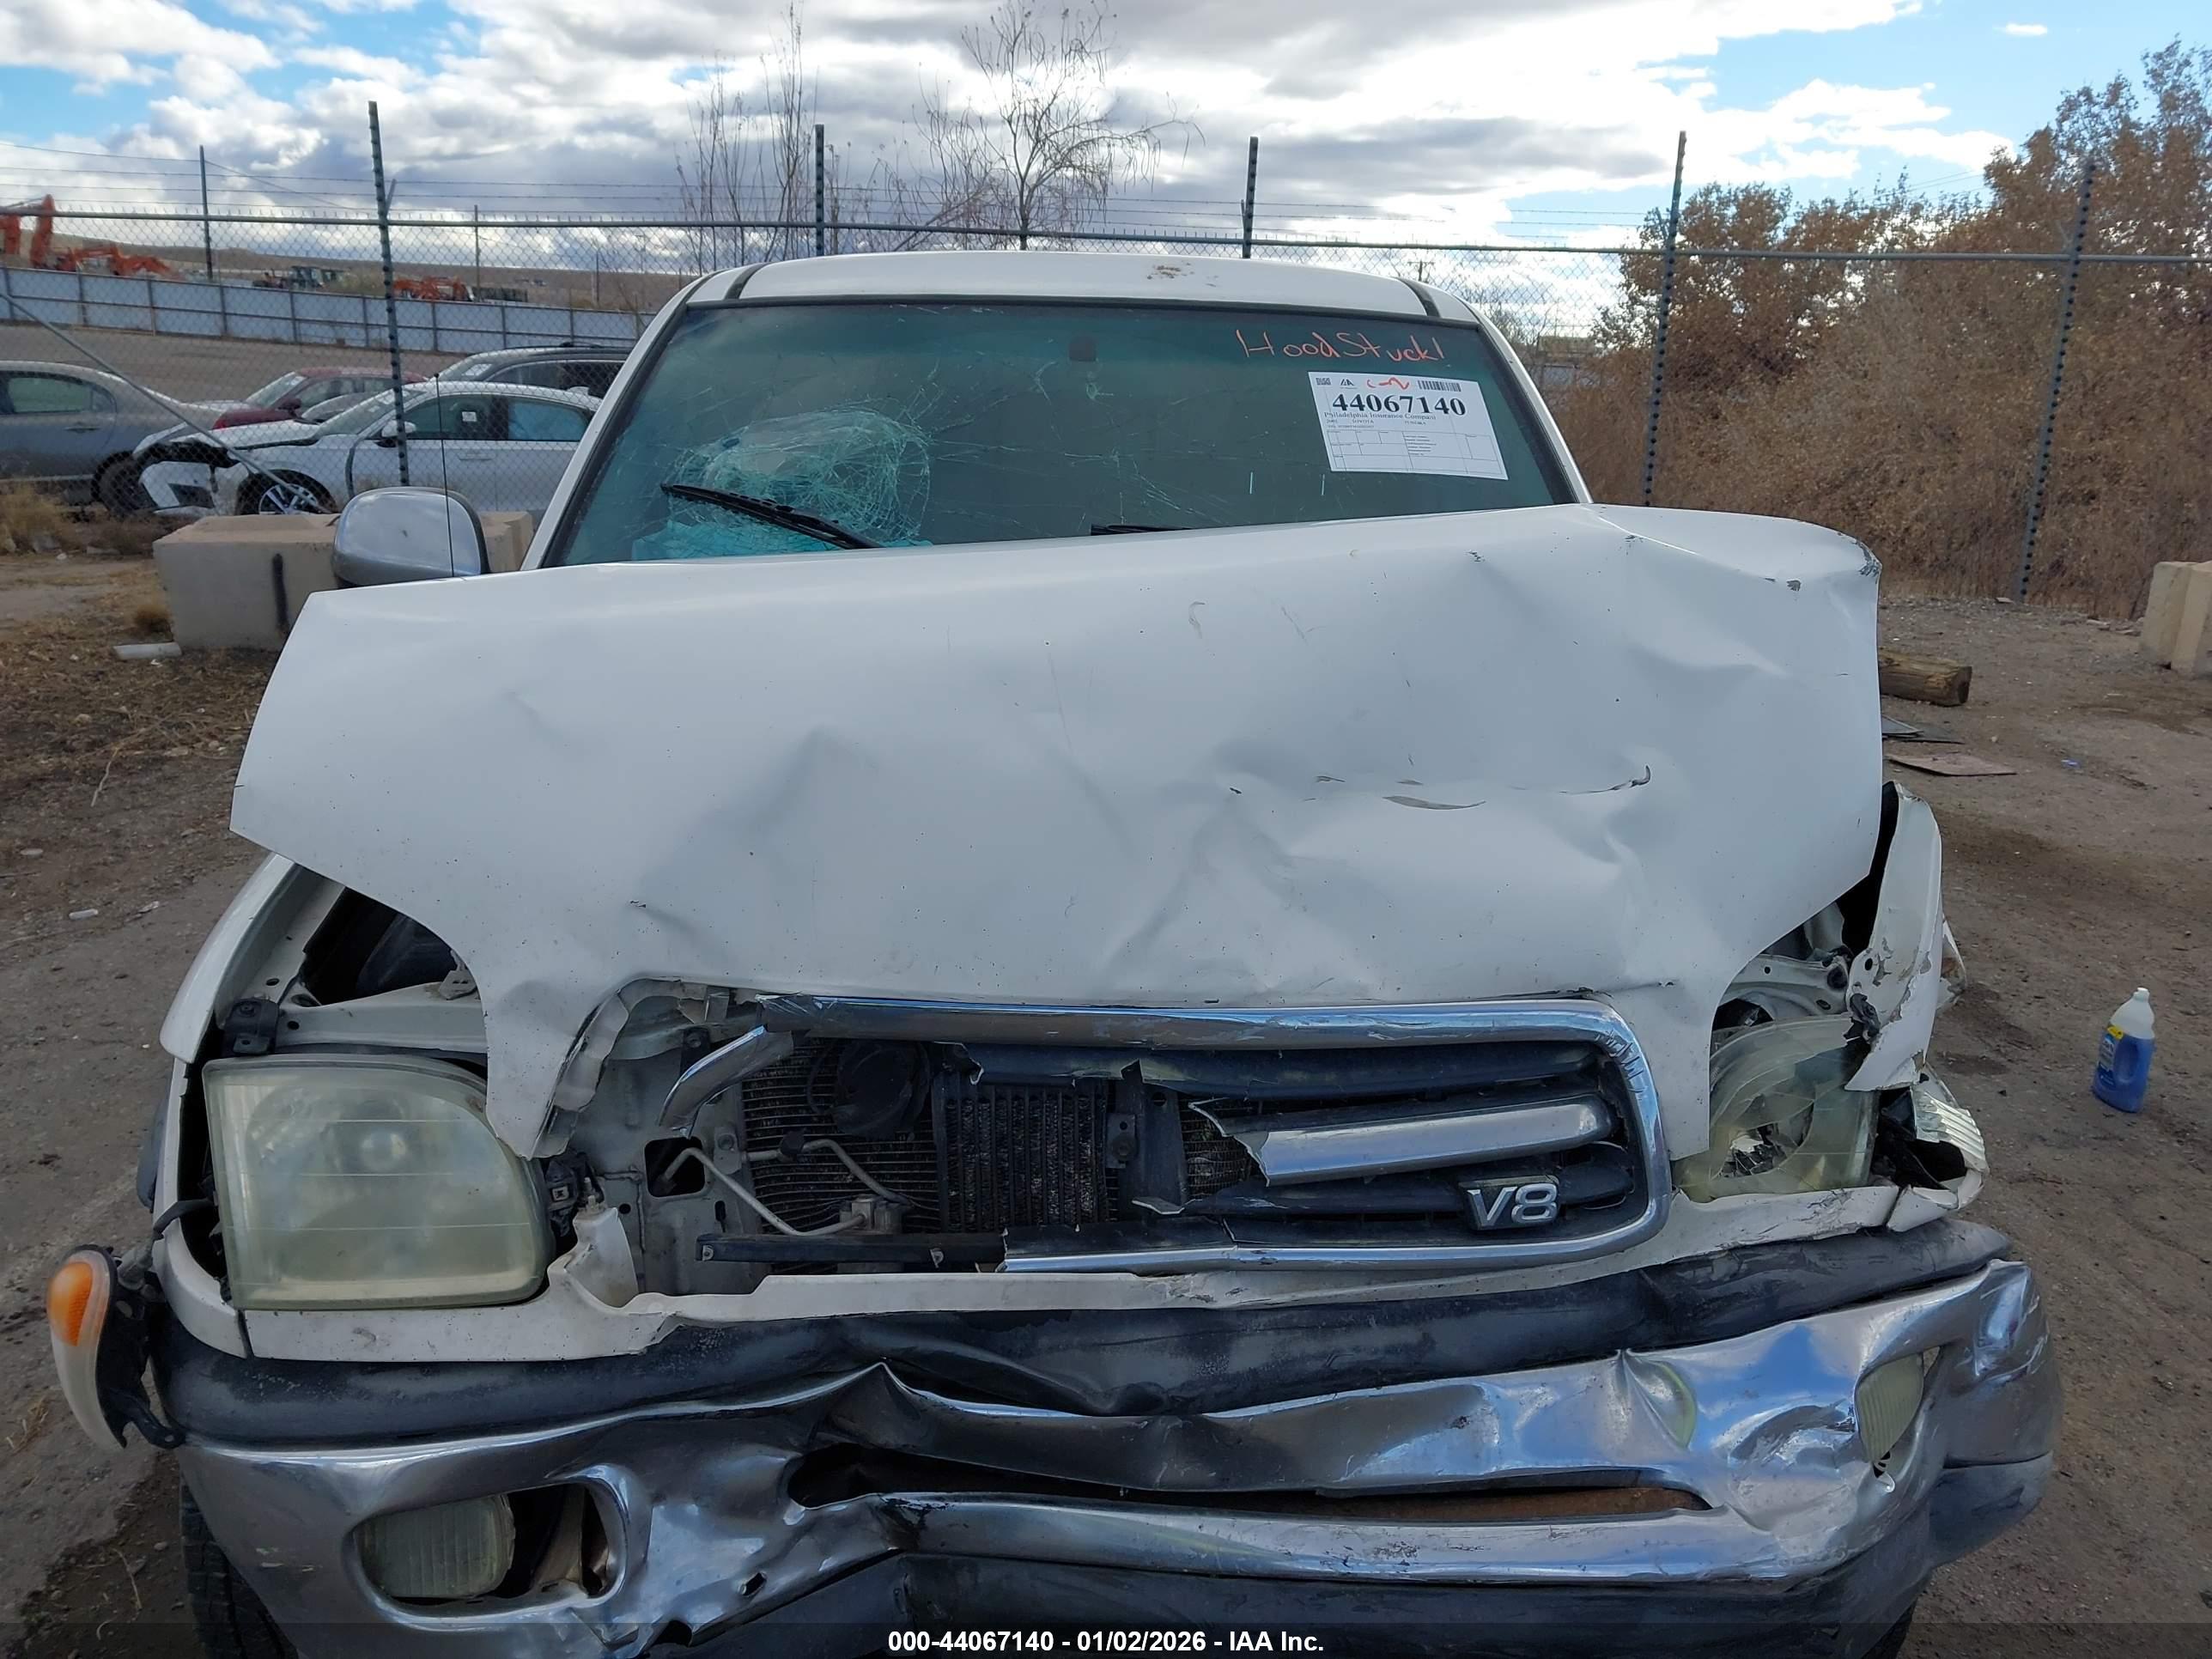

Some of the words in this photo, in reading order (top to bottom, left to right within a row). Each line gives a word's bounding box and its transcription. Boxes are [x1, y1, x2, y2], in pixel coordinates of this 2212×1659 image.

[1236, 329, 1340, 358] Hood
[1332, 393, 1466, 416] 44067140
[1467, 1182, 1558, 1228] V8
